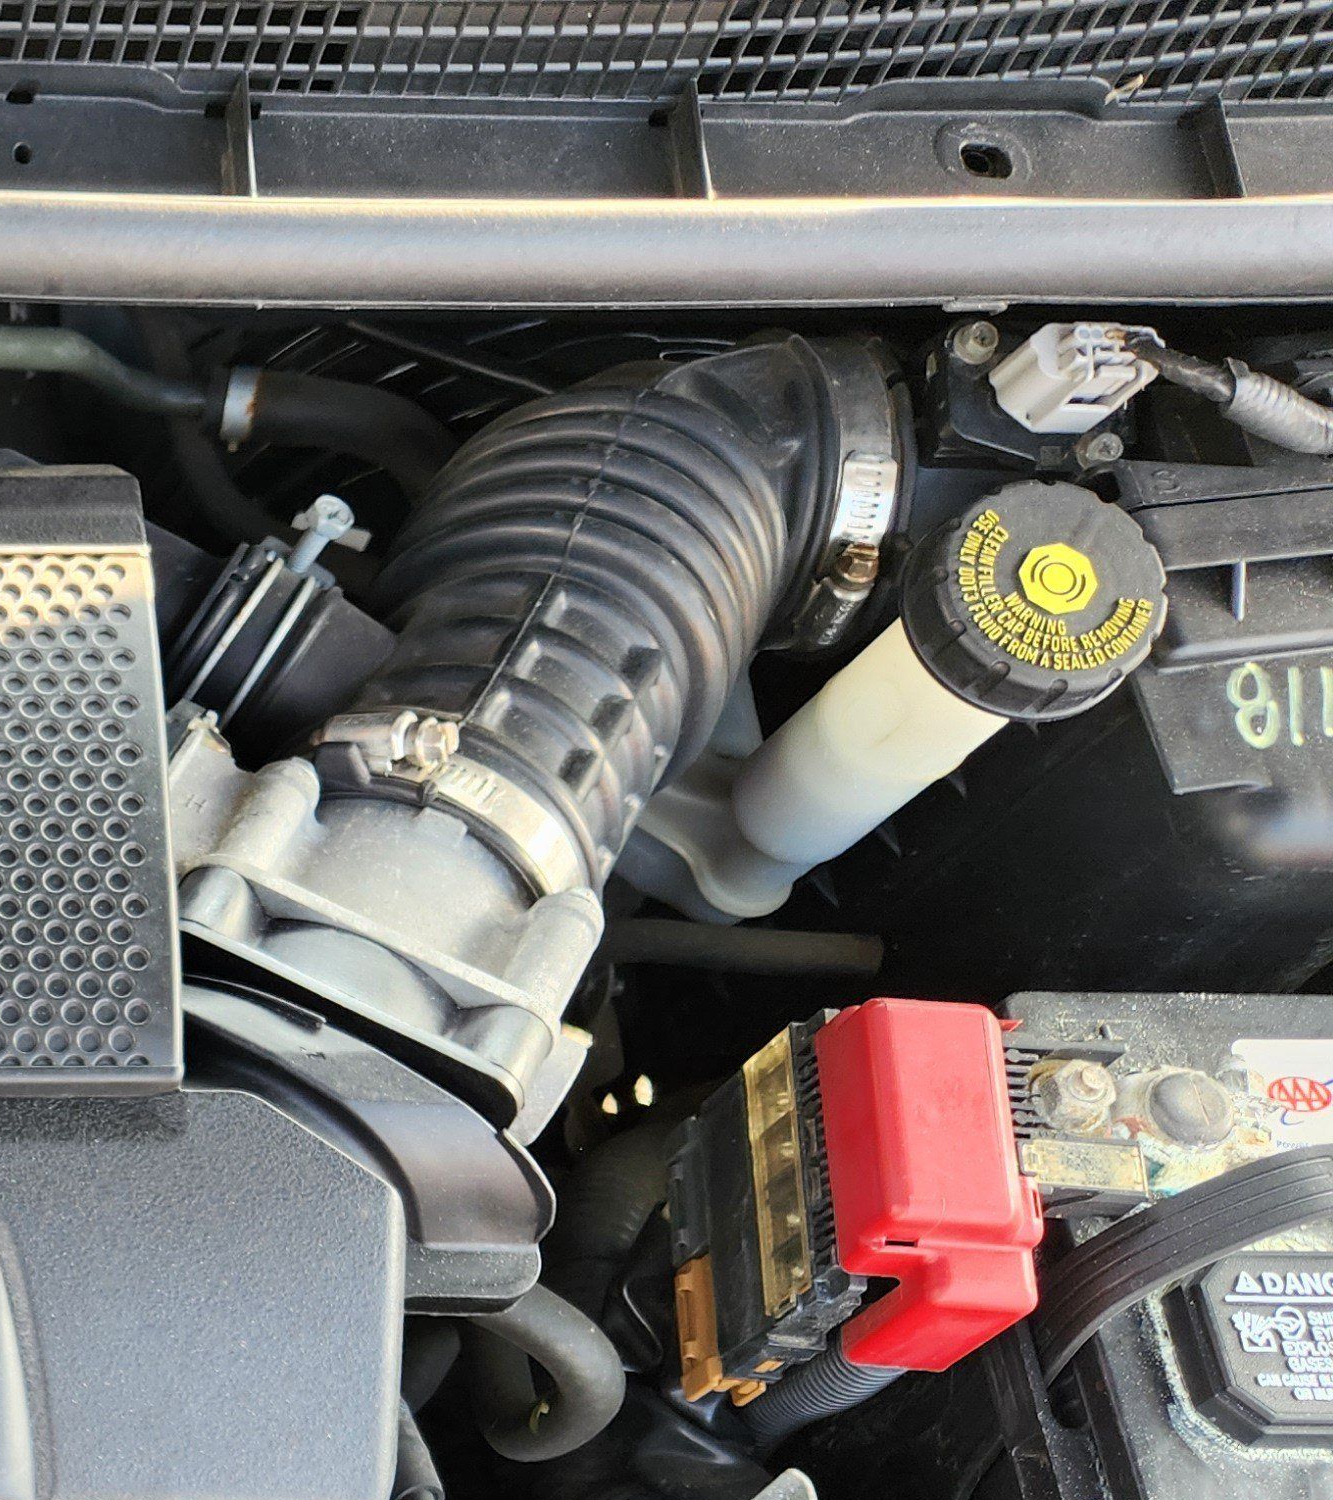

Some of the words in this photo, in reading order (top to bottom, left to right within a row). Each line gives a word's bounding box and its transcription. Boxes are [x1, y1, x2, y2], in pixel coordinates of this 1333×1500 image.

[972, 509, 1000, 535] USE
[959, 530, 983, 566] ONLY
[979, 525, 1009, 567] CLEAN
[958, 566, 979, 603] DOT3
[977, 566, 1005, 614] FILLER
[968, 602, 1004, 641] FLUID
[996, 610, 1026, 635] CAP
[1003, 591, 1067, 636] WARNING
[1080, 596, 1136, 650] REMOVING
[1104, 598, 1155, 661] CONTAINER
[998, 633, 1039, 665] FROM
[1022, 628, 1081, 653] BEFORE
[1039, 652, 1051, 669] A
[1053, 648, 1107, 671] SEALED
